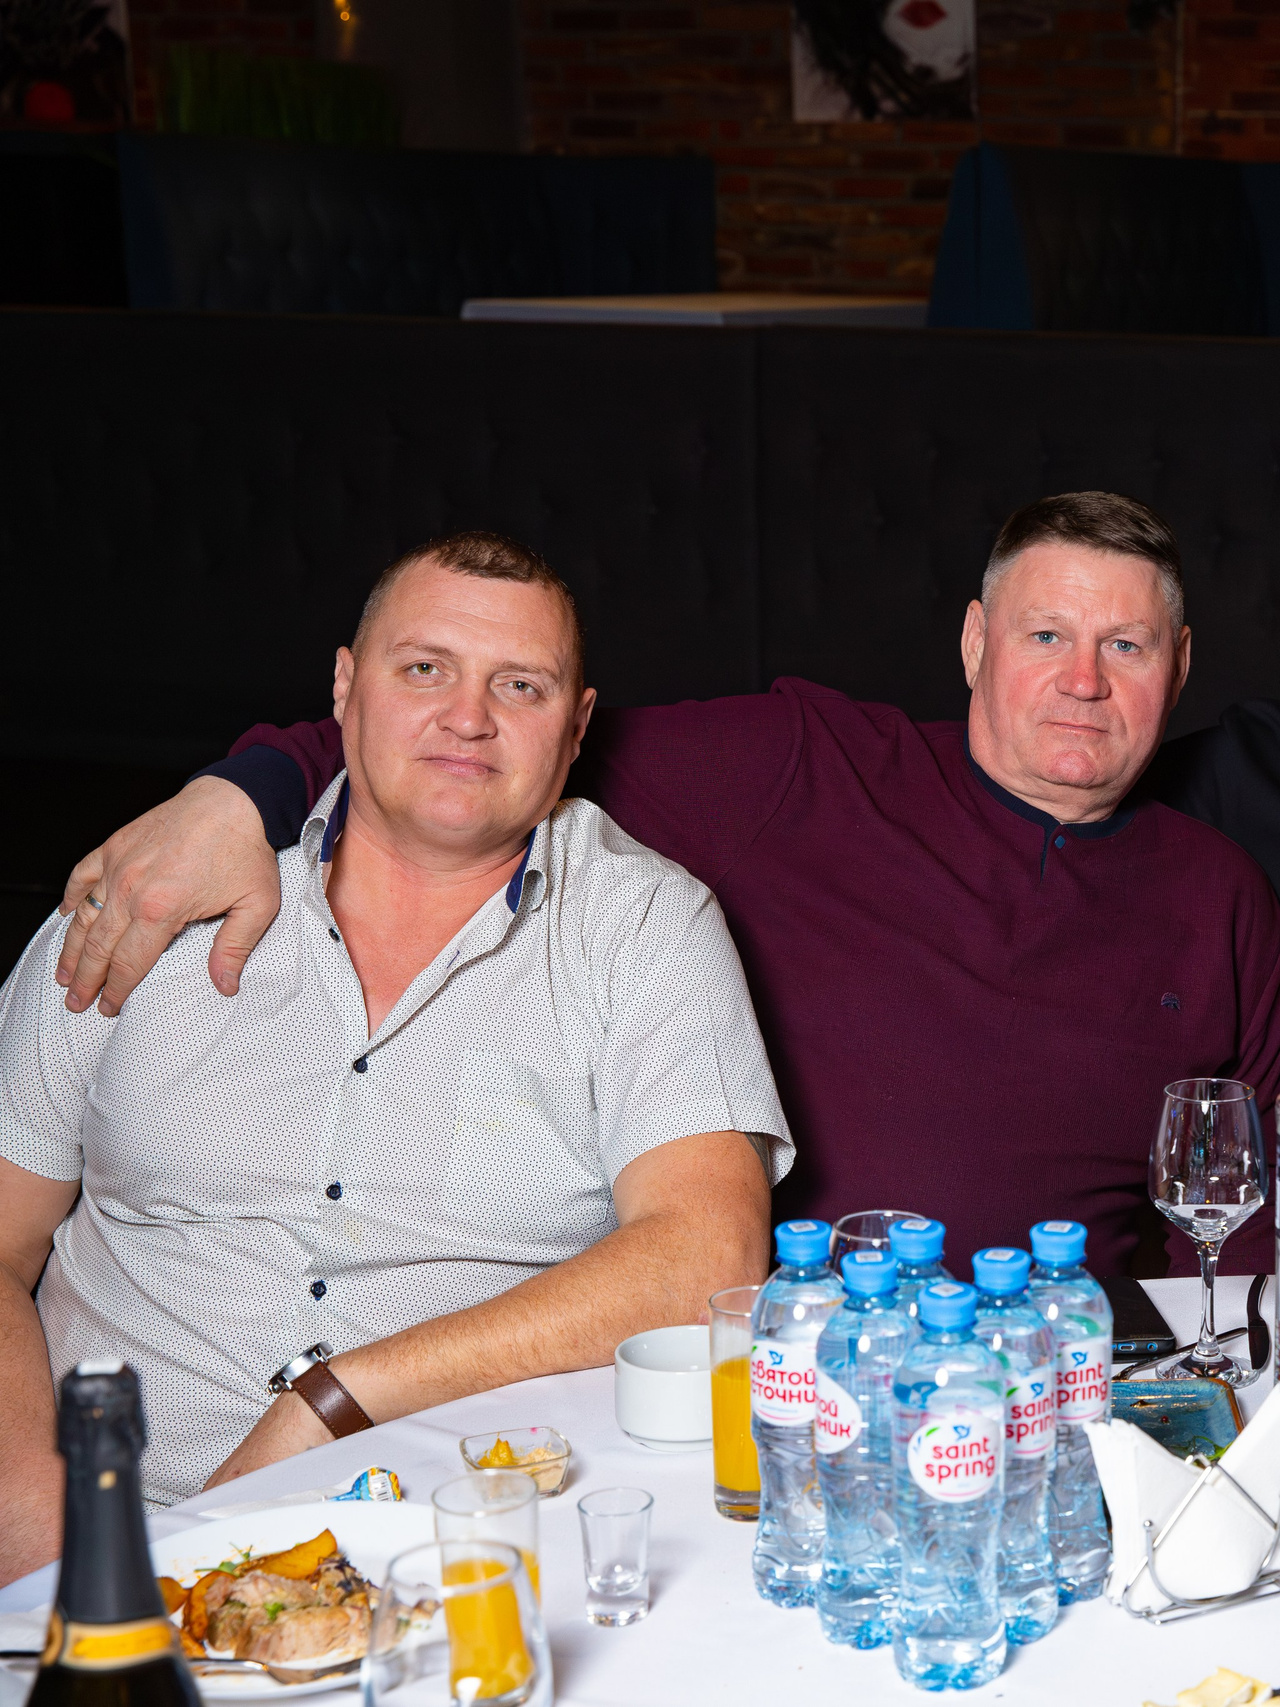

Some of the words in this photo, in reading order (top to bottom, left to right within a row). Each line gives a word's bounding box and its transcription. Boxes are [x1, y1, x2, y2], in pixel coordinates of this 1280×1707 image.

[1056, 1380, 1109, 1409] pring
[932, 1436, 990, 1460] saint
[925, 1455, 996, 1484] spring
